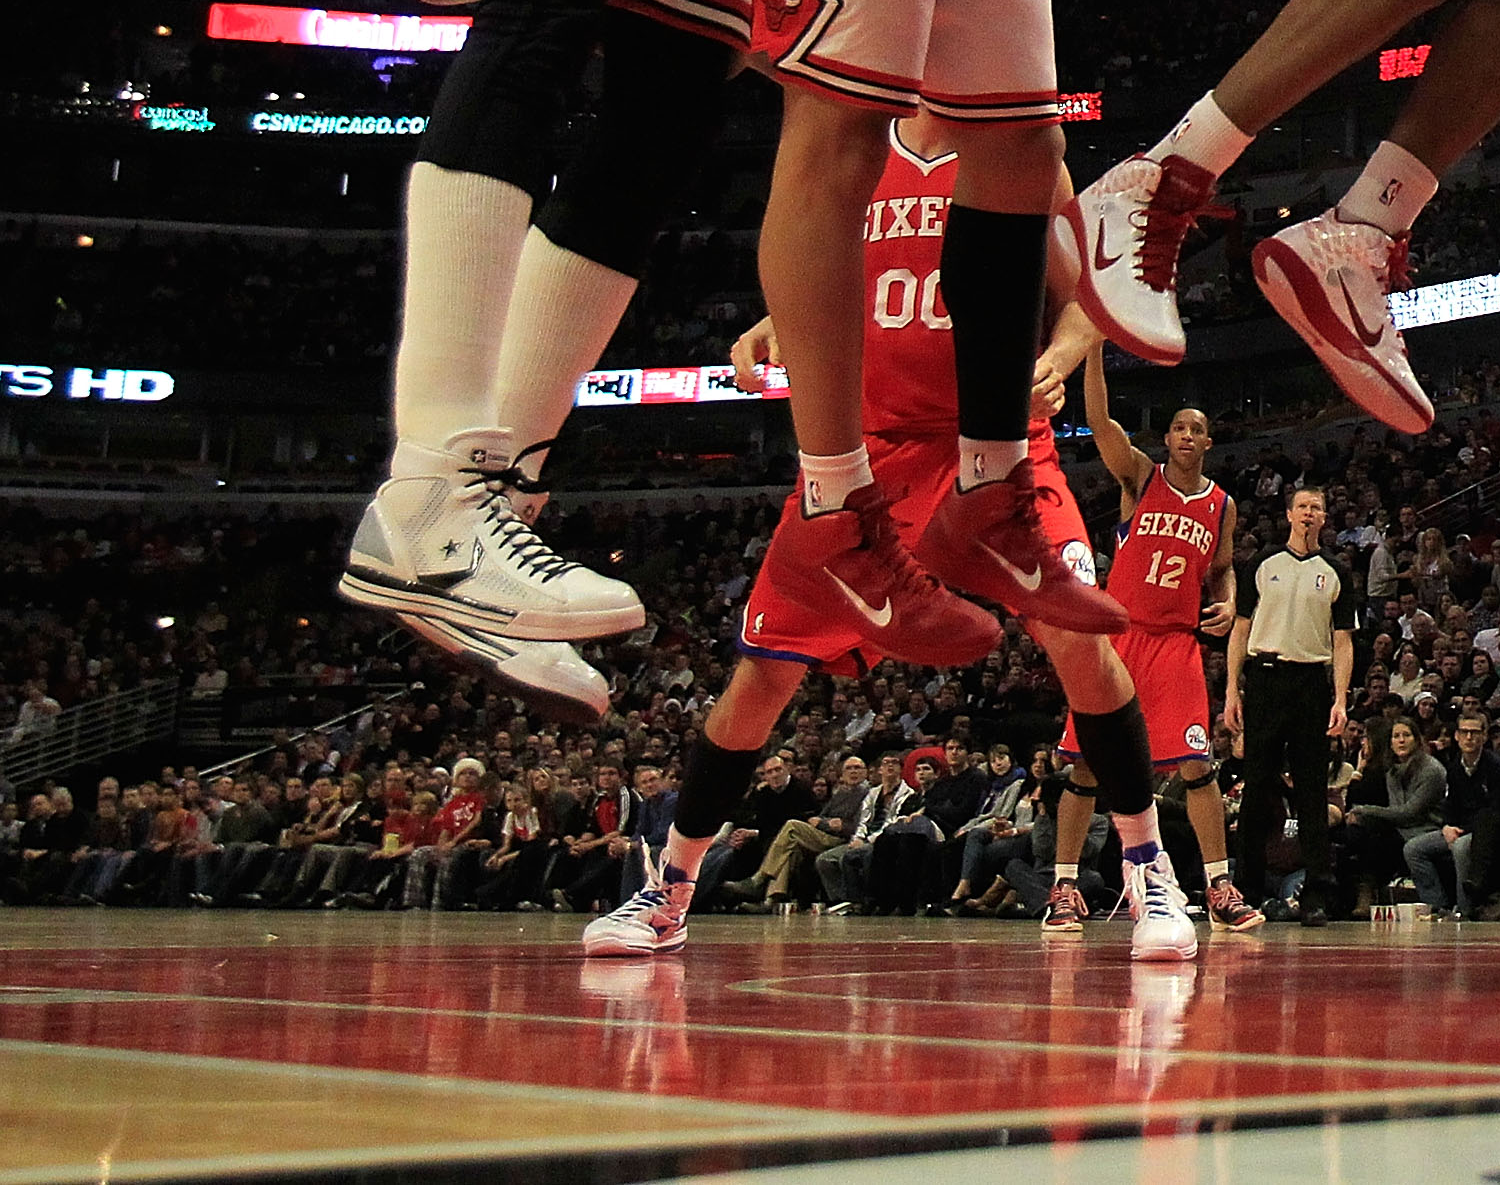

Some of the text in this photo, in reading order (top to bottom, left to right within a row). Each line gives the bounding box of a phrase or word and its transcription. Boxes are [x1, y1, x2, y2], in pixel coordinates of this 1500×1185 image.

[252, 112, 430, 135] CSNCHICAGO.CO
[71, 367, 175, 402] HD
[1136, 512, 1214, 556] SIXERS
[1144, 549, 1187, 590] 12
